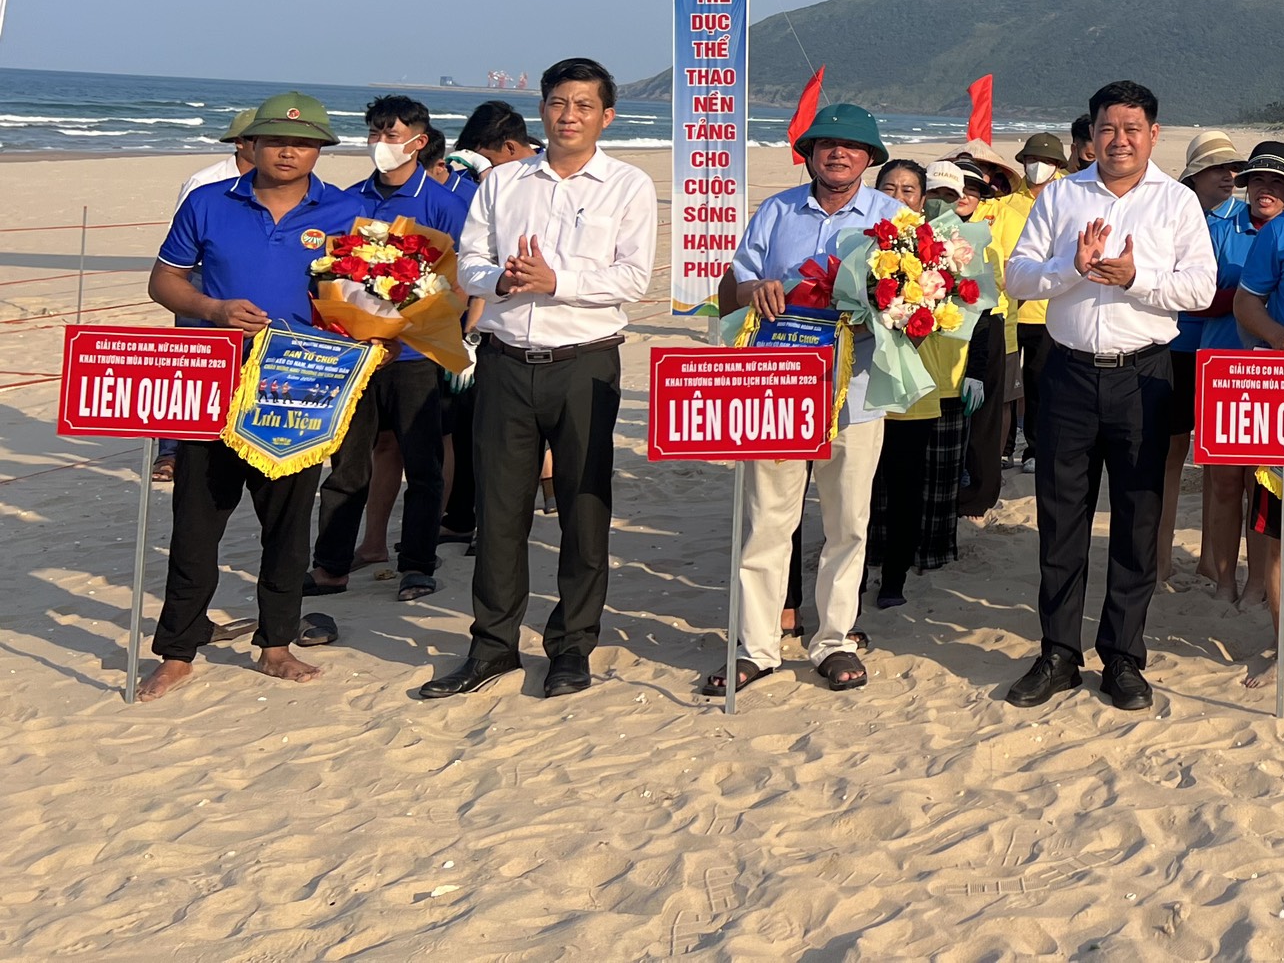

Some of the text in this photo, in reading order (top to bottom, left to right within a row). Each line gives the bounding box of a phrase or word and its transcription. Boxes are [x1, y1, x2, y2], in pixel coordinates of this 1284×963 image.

[692, 14, 730, 34] DỤC
[693, 36, 729, 58] THỂ
[686, 69, 736, 85] THAO
[694, 92, 734, 113] NỀN
[684, 119, 736, 141] TẢNG
[691, 151, 730, 168] CHO
[684, 176, 736, 198] CUỘC
[684, 201, 736, 223] SỐNG
[684, 234, 736, 253] HẠNH
[96, 339, 110, 350] GIẢI
[112, 340, 126, 351] KÉO
[127, 342, 136, 351] CO
[138, 343, 156, 353] NAM,
[170, 343, 188, 353] CHÀO
[190, 343, 211, 354] MỪNG
[284, 350, 302, 359] BAN
[79, 354, 96, 364] KHAI
[126, 355, 142, 365] MÙA
[144, 357, 154, 365] DU
[155, 357, 170, 368] LỊCH
[208, 359, 226, 368] 2026
[682, 361, 696, 373] GIẢI
[698, 362, 712, 373] KÉO
[714, 363, 724, 372] CO
[724, 362, 744, 372] NAM,
[758, 360, 778, 371] CHÀO
[779, 360, 800, 371] MỪNG
[1229, 362, 1244, 375] GIẢI
[1246, 364, 1260, 375] KÉO
[1262, 366, 1272, 375] CO
[665, 378, 682, 387] KHAI
[714, 375, 730, 386] MÙA
[732, 377, 742, 386] DU
[743, 376, 760, 387] LỊCH
[799, 376, 817, 385] 2026
[1212, 379, 1230, 389] KHAI
[1262, 378, 1279, 390] MÙA
[79, 368, 220, 424] LIÊN QUÂN 4
[252, 407, 322, 436] Lưu Niệm
[669, 389, 814, 445] LIÊN QUÂN 3
[1216, 392, 1270, 445] LIÊN
